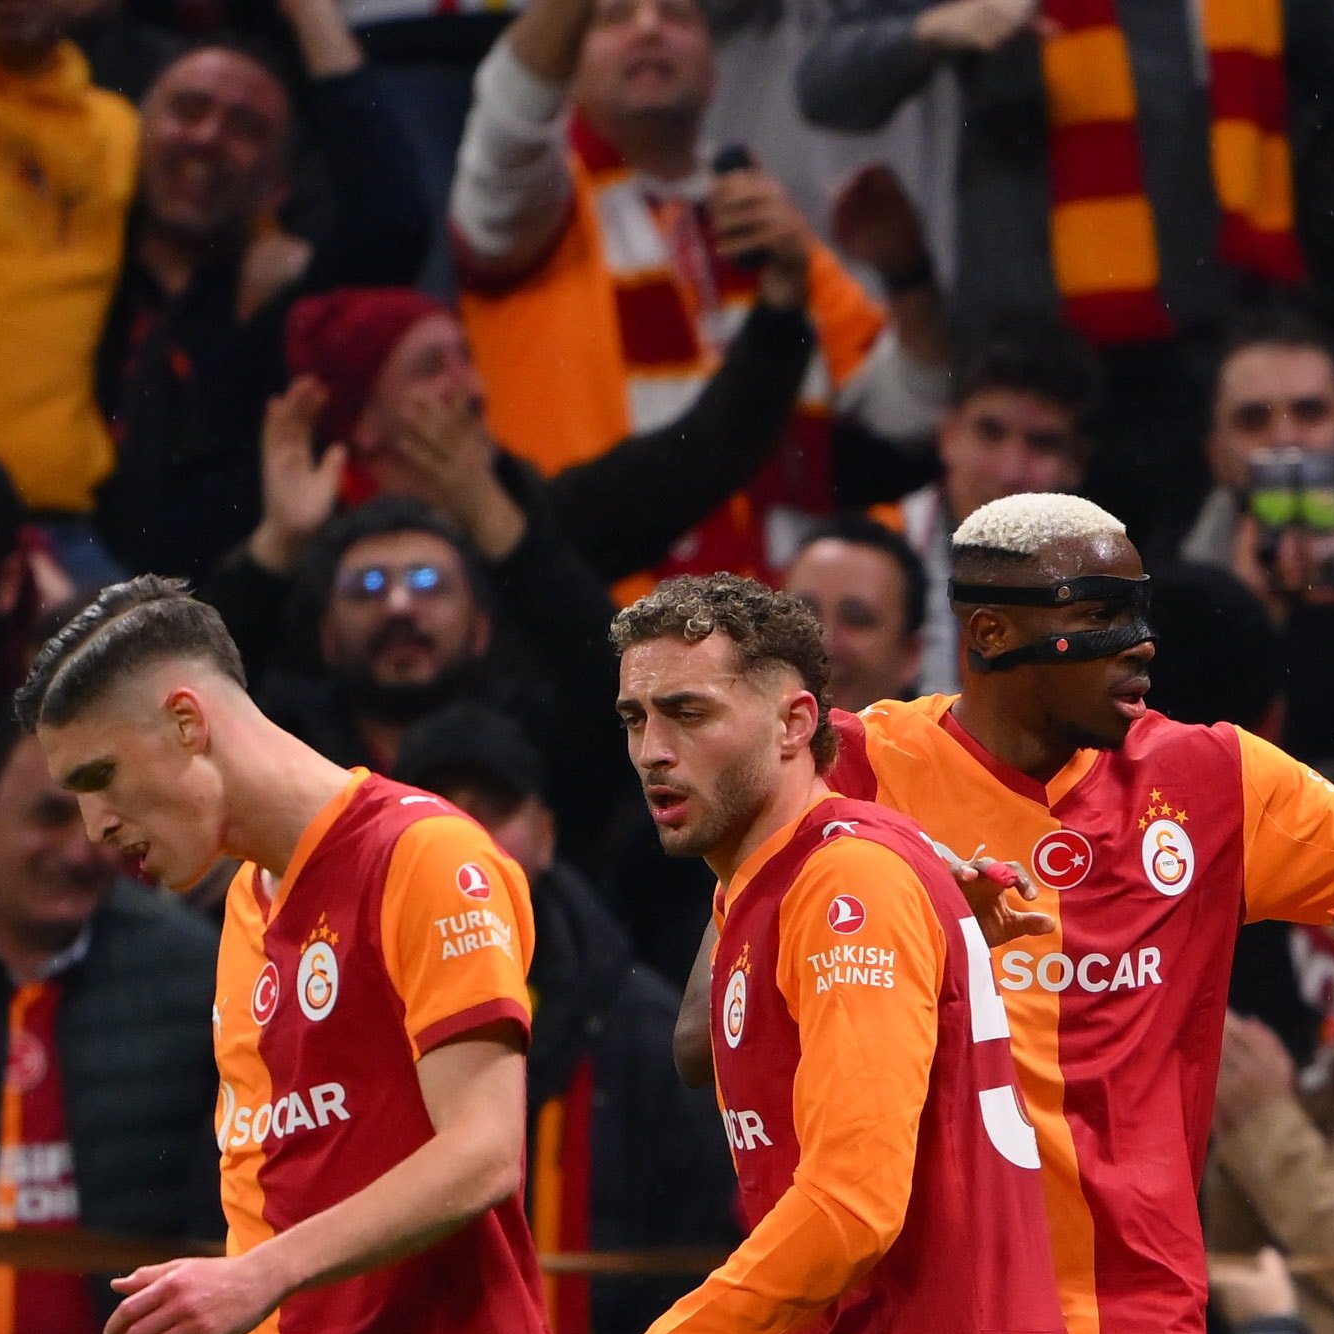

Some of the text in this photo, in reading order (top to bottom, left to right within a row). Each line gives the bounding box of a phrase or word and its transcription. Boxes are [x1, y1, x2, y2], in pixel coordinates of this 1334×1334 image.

[807, 944, 895, 974] TURKISH
[999, 946, 1163, 994] SOCAR
[816, 965, 895, 995] AILINES
[231, 1082, 351, 1148] SOCAR
